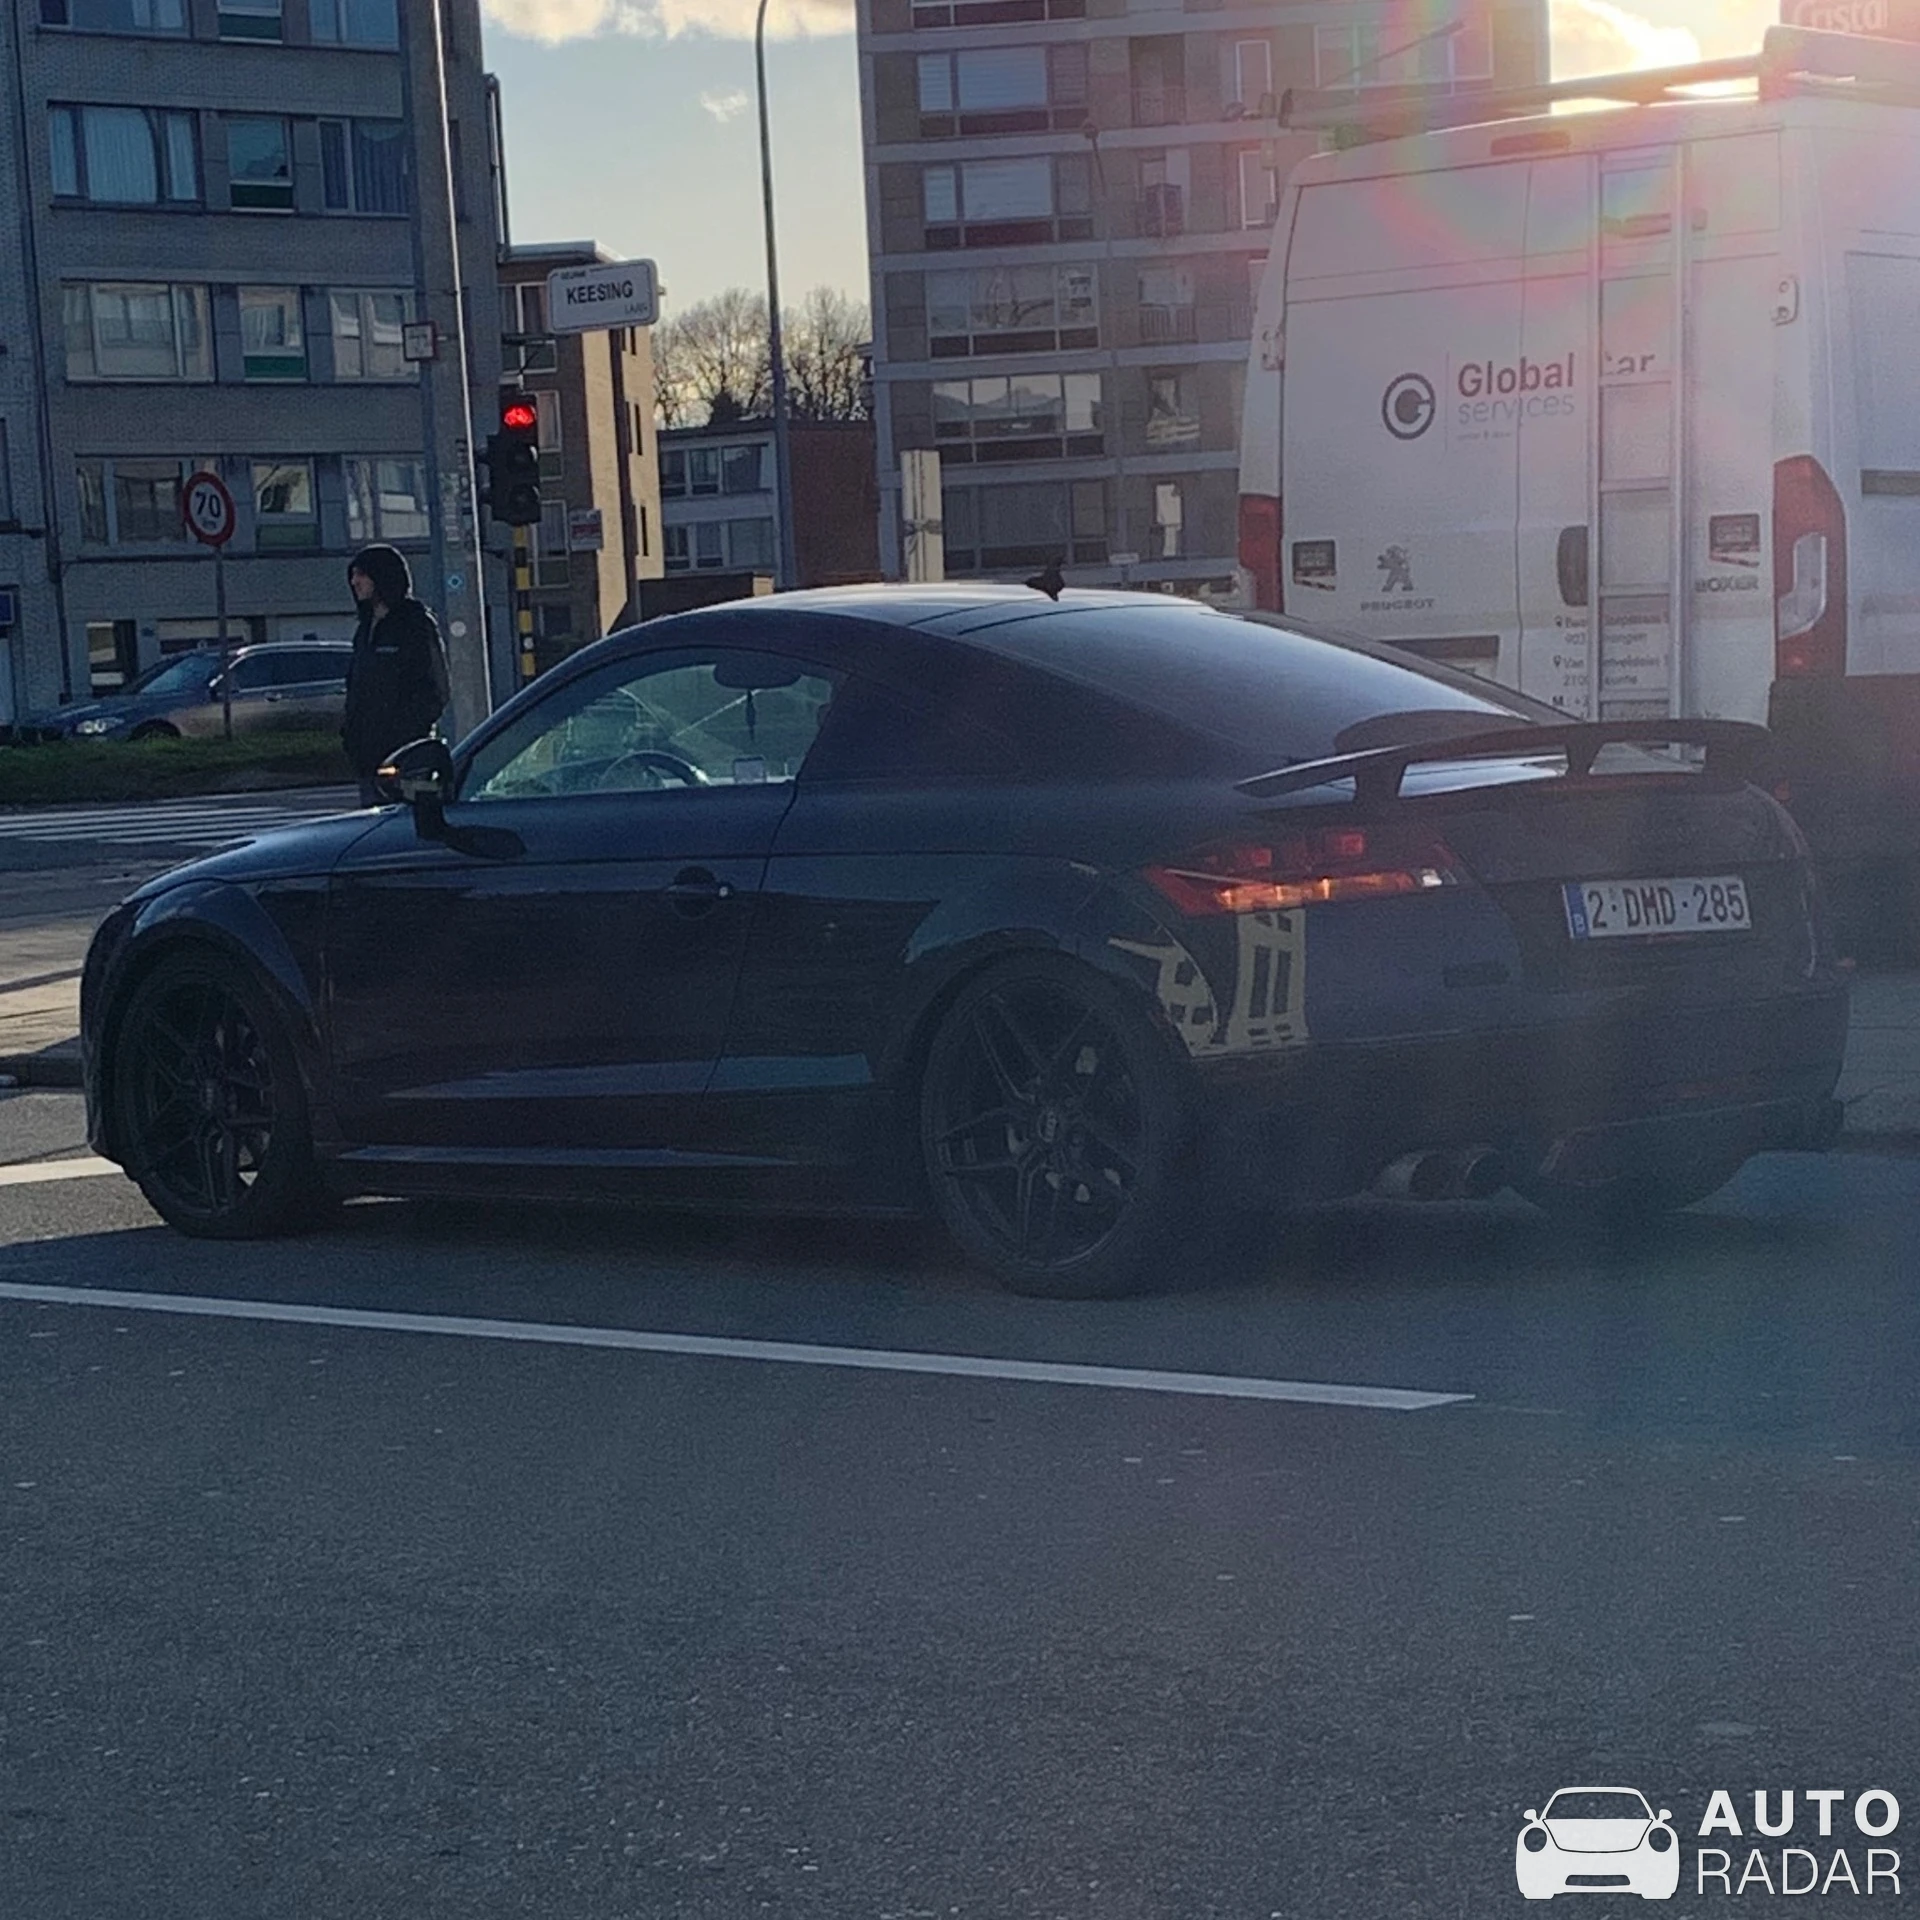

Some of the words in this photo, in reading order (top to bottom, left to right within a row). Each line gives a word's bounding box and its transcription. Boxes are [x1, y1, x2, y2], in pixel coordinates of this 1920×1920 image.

[566, 280, 634, 305] KEESING
[1457, 352, 1575, 398] Global
[1457, 394, 1576, 426] services
[195, 491, 221, 518] 70
